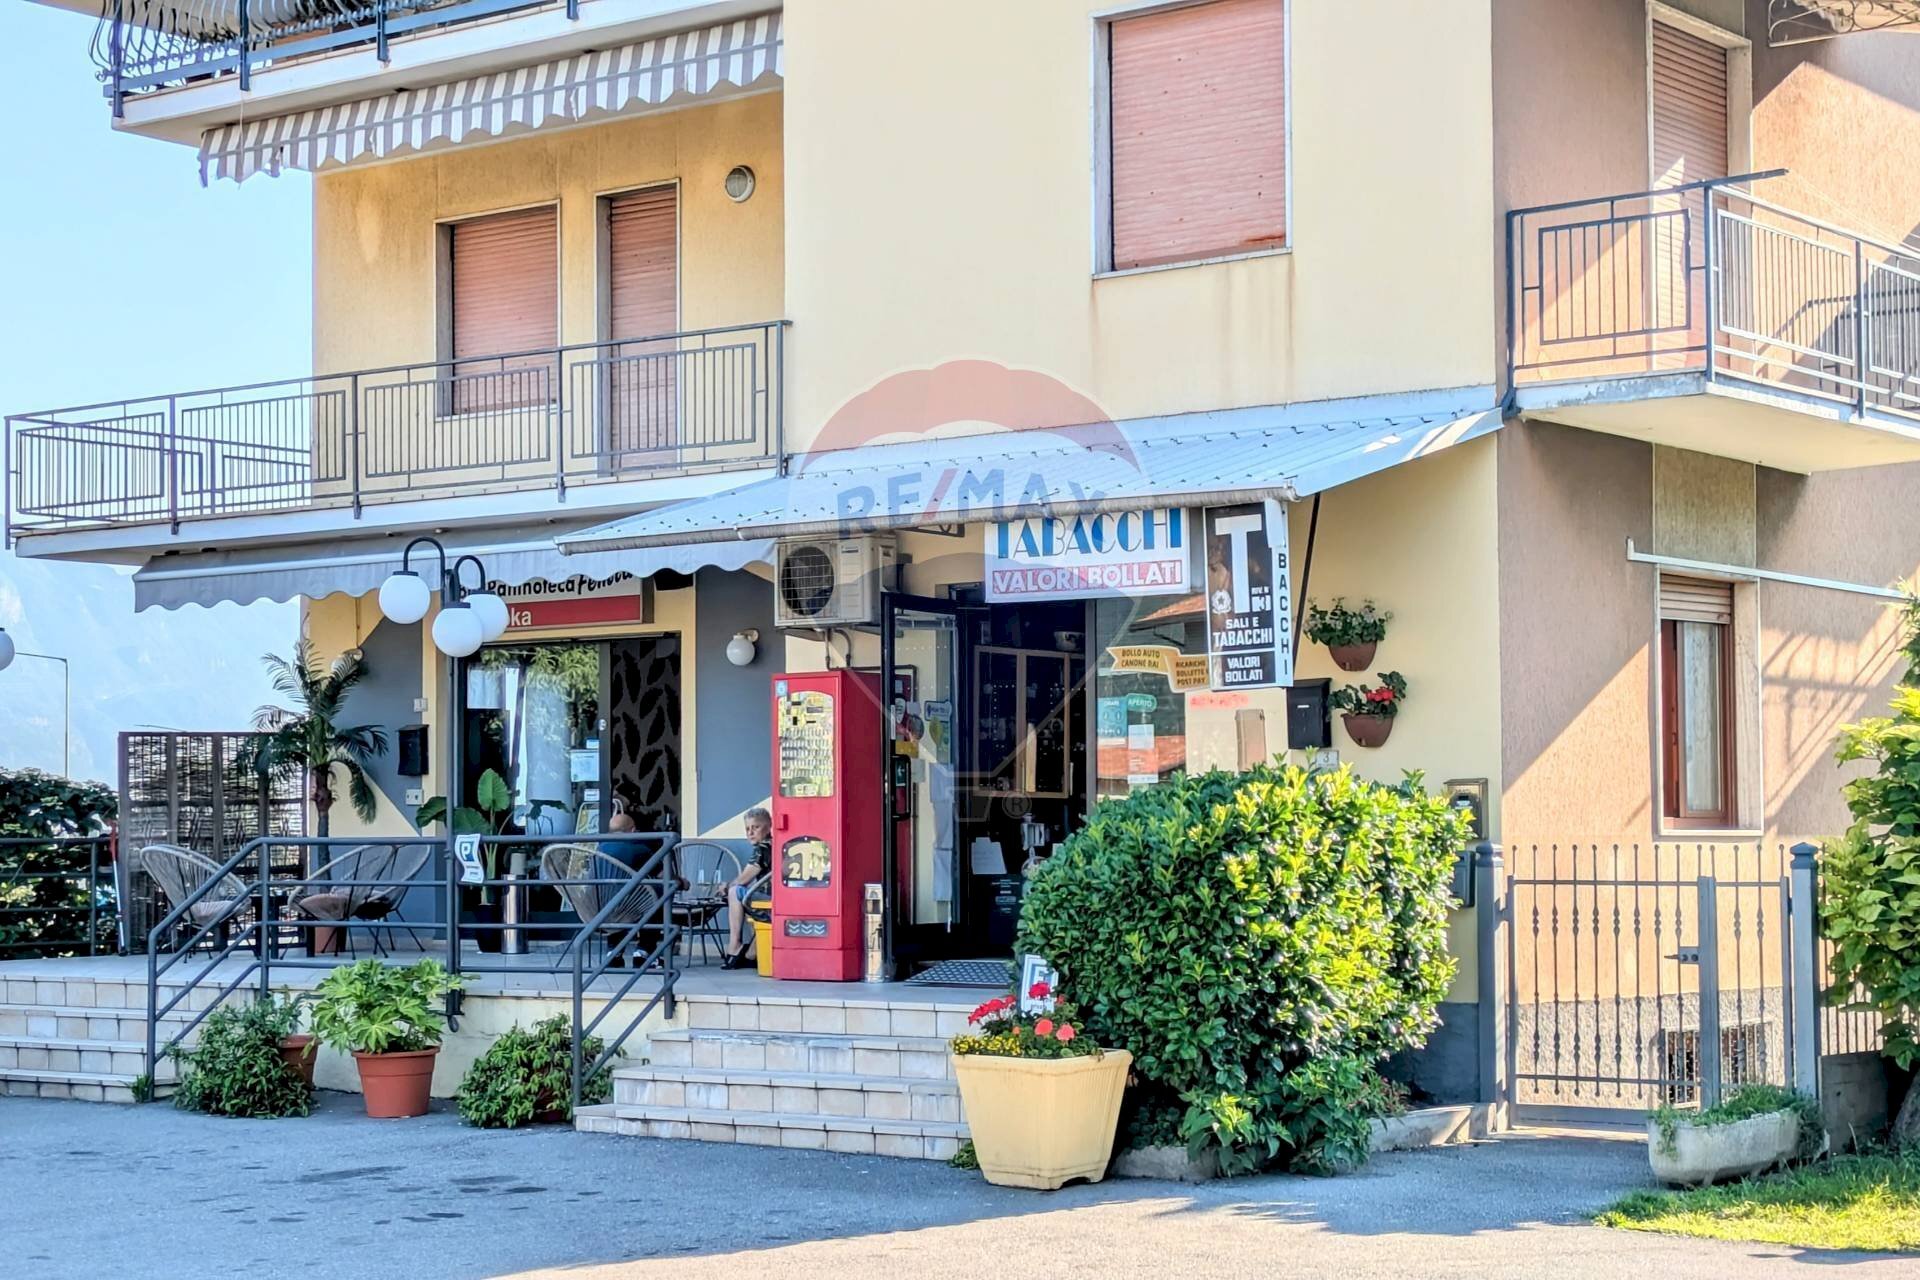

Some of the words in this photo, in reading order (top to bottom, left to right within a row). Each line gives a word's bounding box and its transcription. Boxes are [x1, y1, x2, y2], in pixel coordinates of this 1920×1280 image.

[992, 507, 1182, 559] TABACCHI
[1215, 514, 1262, 613] T
[994, 567, 1079, 593] VALORI
[1088, 562, 1180, 587] BOLLATI
[1226, 618, 1249, 630] SALI
[1252, 617, 1259, 627] E
[1213, 628, 1273, 648] TABACCHI
[1121, 649, 1142, 657] BOLLO
[1143, 650, 1160, 658] AUTO
[1121, 659, 1147, 667] CANONE
[1227, 656, 1260, 669] VALORI
[1225, 670, 1262, 682] BOLLATI
[1128, 699, 1152, 708] APERTO
